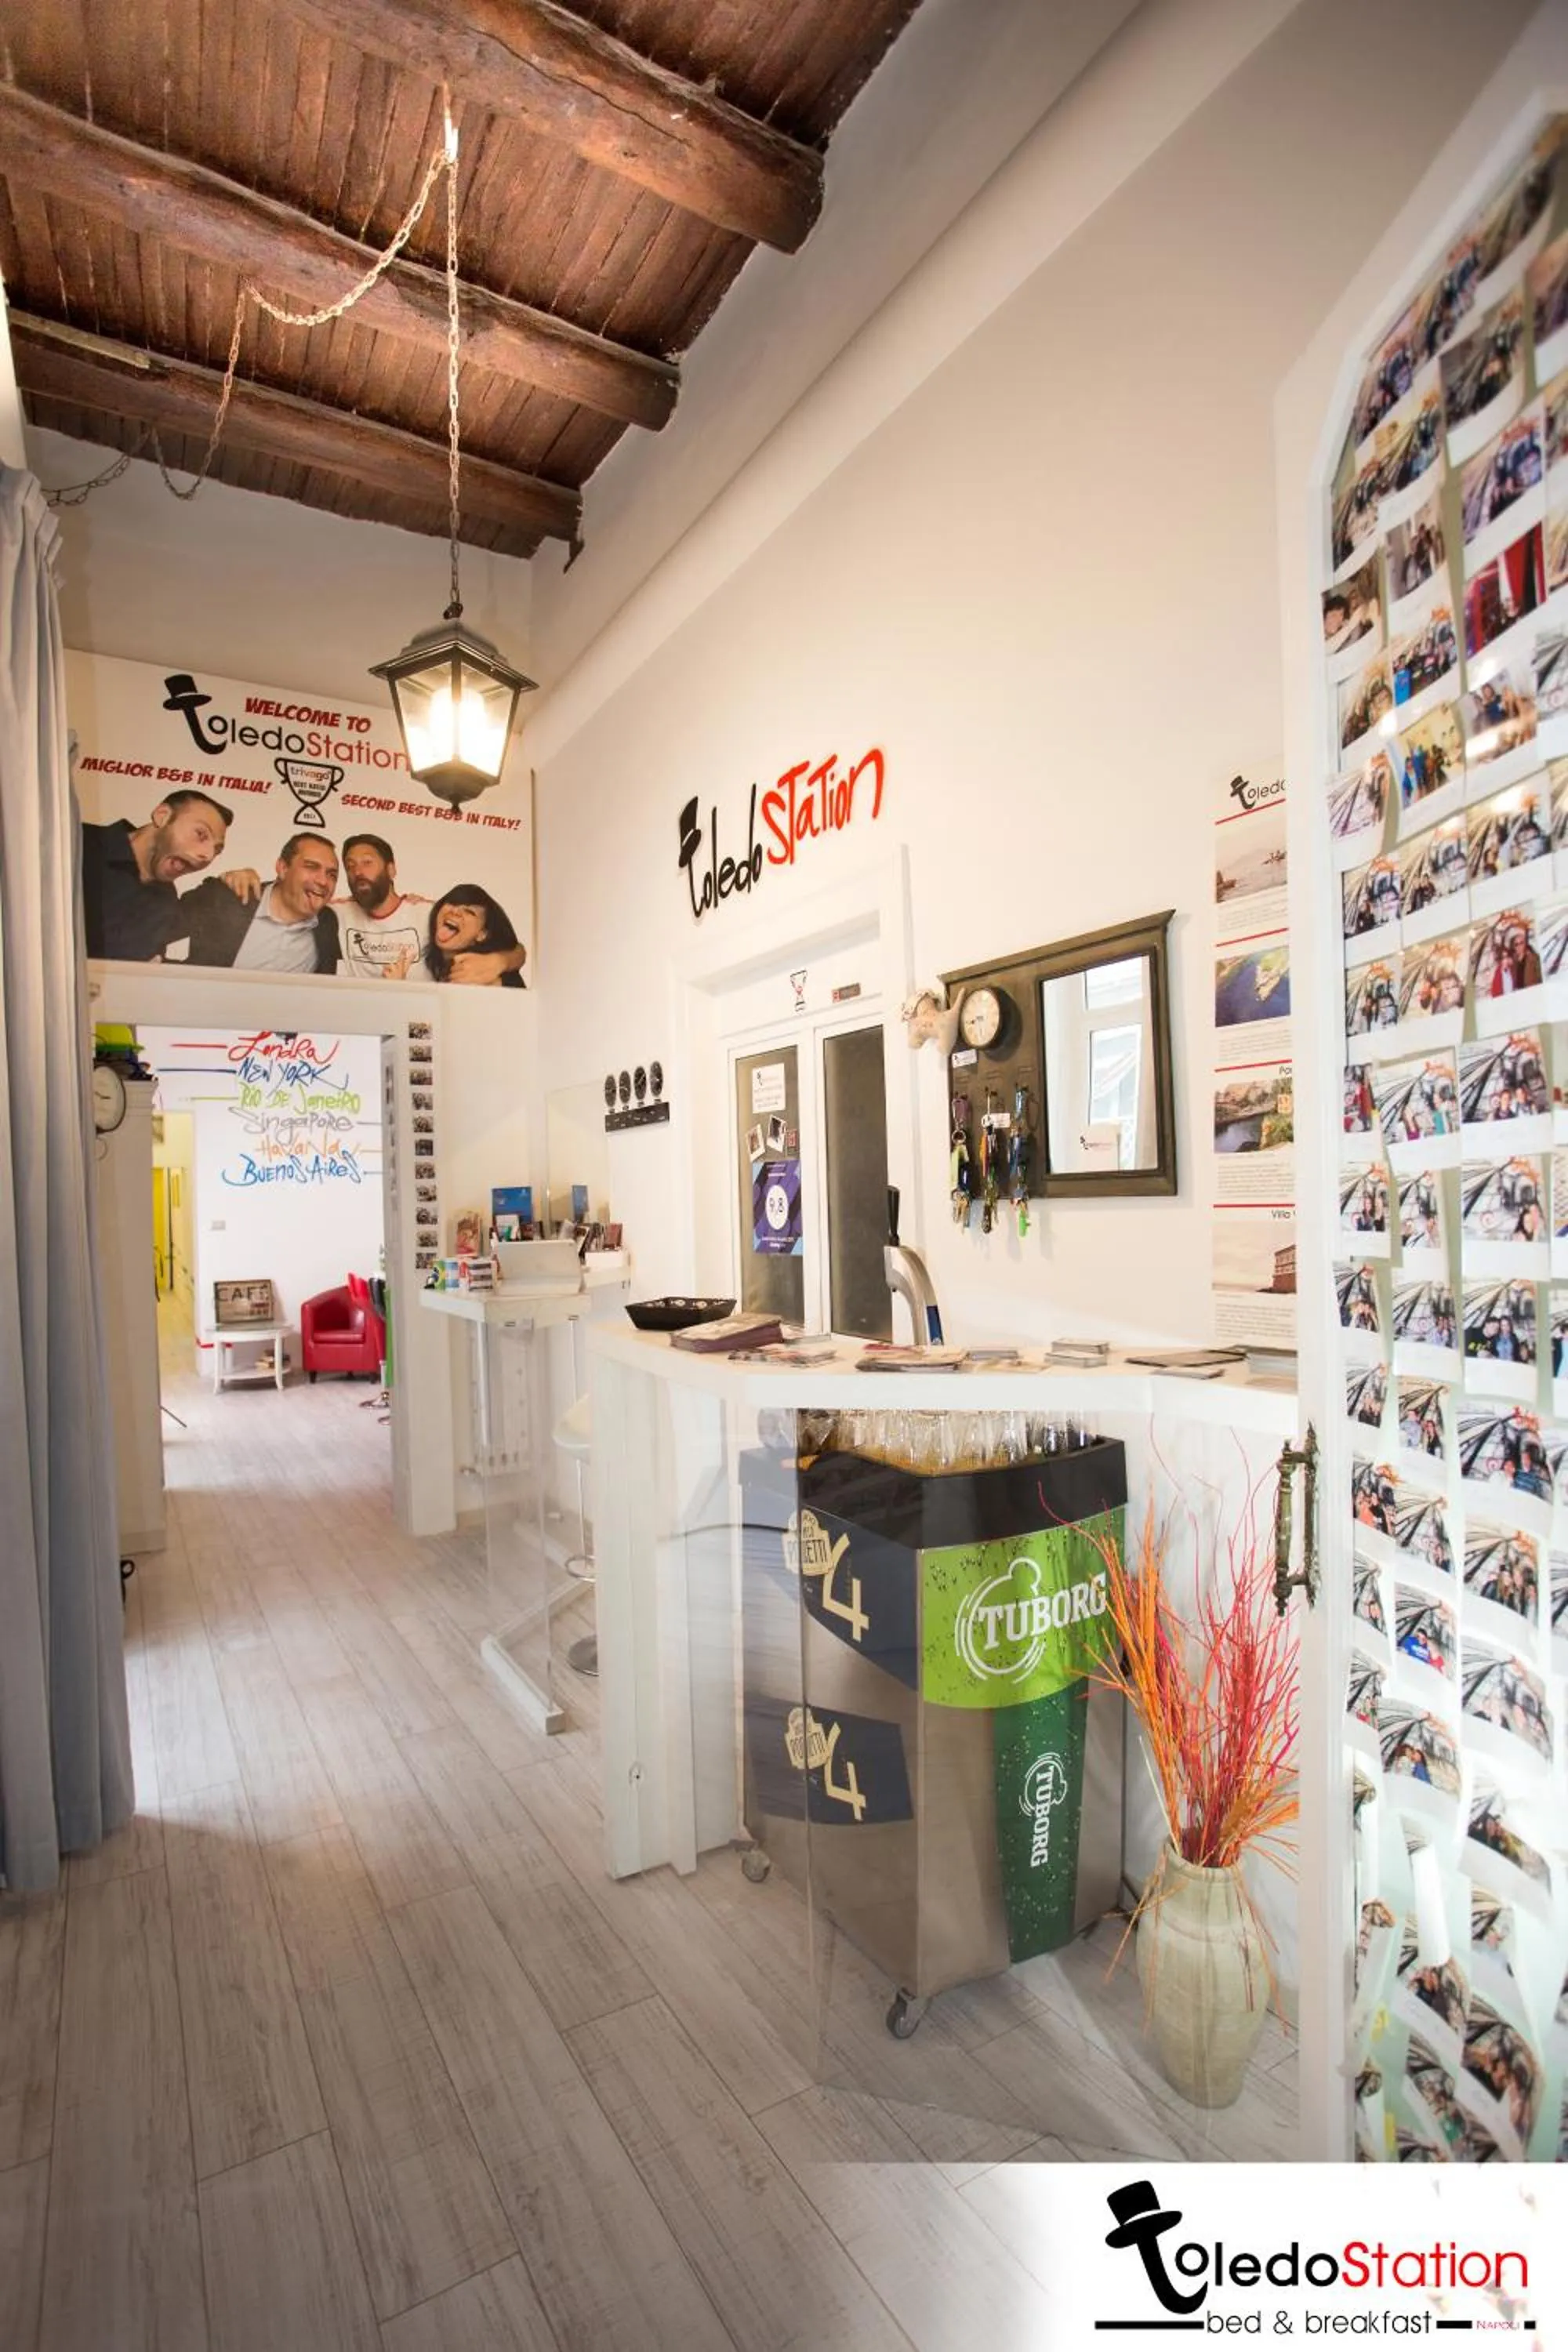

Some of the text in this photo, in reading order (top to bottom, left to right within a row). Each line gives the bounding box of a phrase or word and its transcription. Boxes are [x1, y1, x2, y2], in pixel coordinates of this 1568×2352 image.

[245, 697, 372, 733] WELCOME TO
[80, 757, 273, 794] MIGLIOR B&B IN ITALIA!
[341, 793, 521, 830] SECOND BEST B&B IN ITALY!
[822, 1532, 870, 1643] 4
[977, 1571, 1107, 1650] TUBORG
[825, 1721, 866, 1821] 4
[1029, 1764, 1056, 1867] TUBORG
